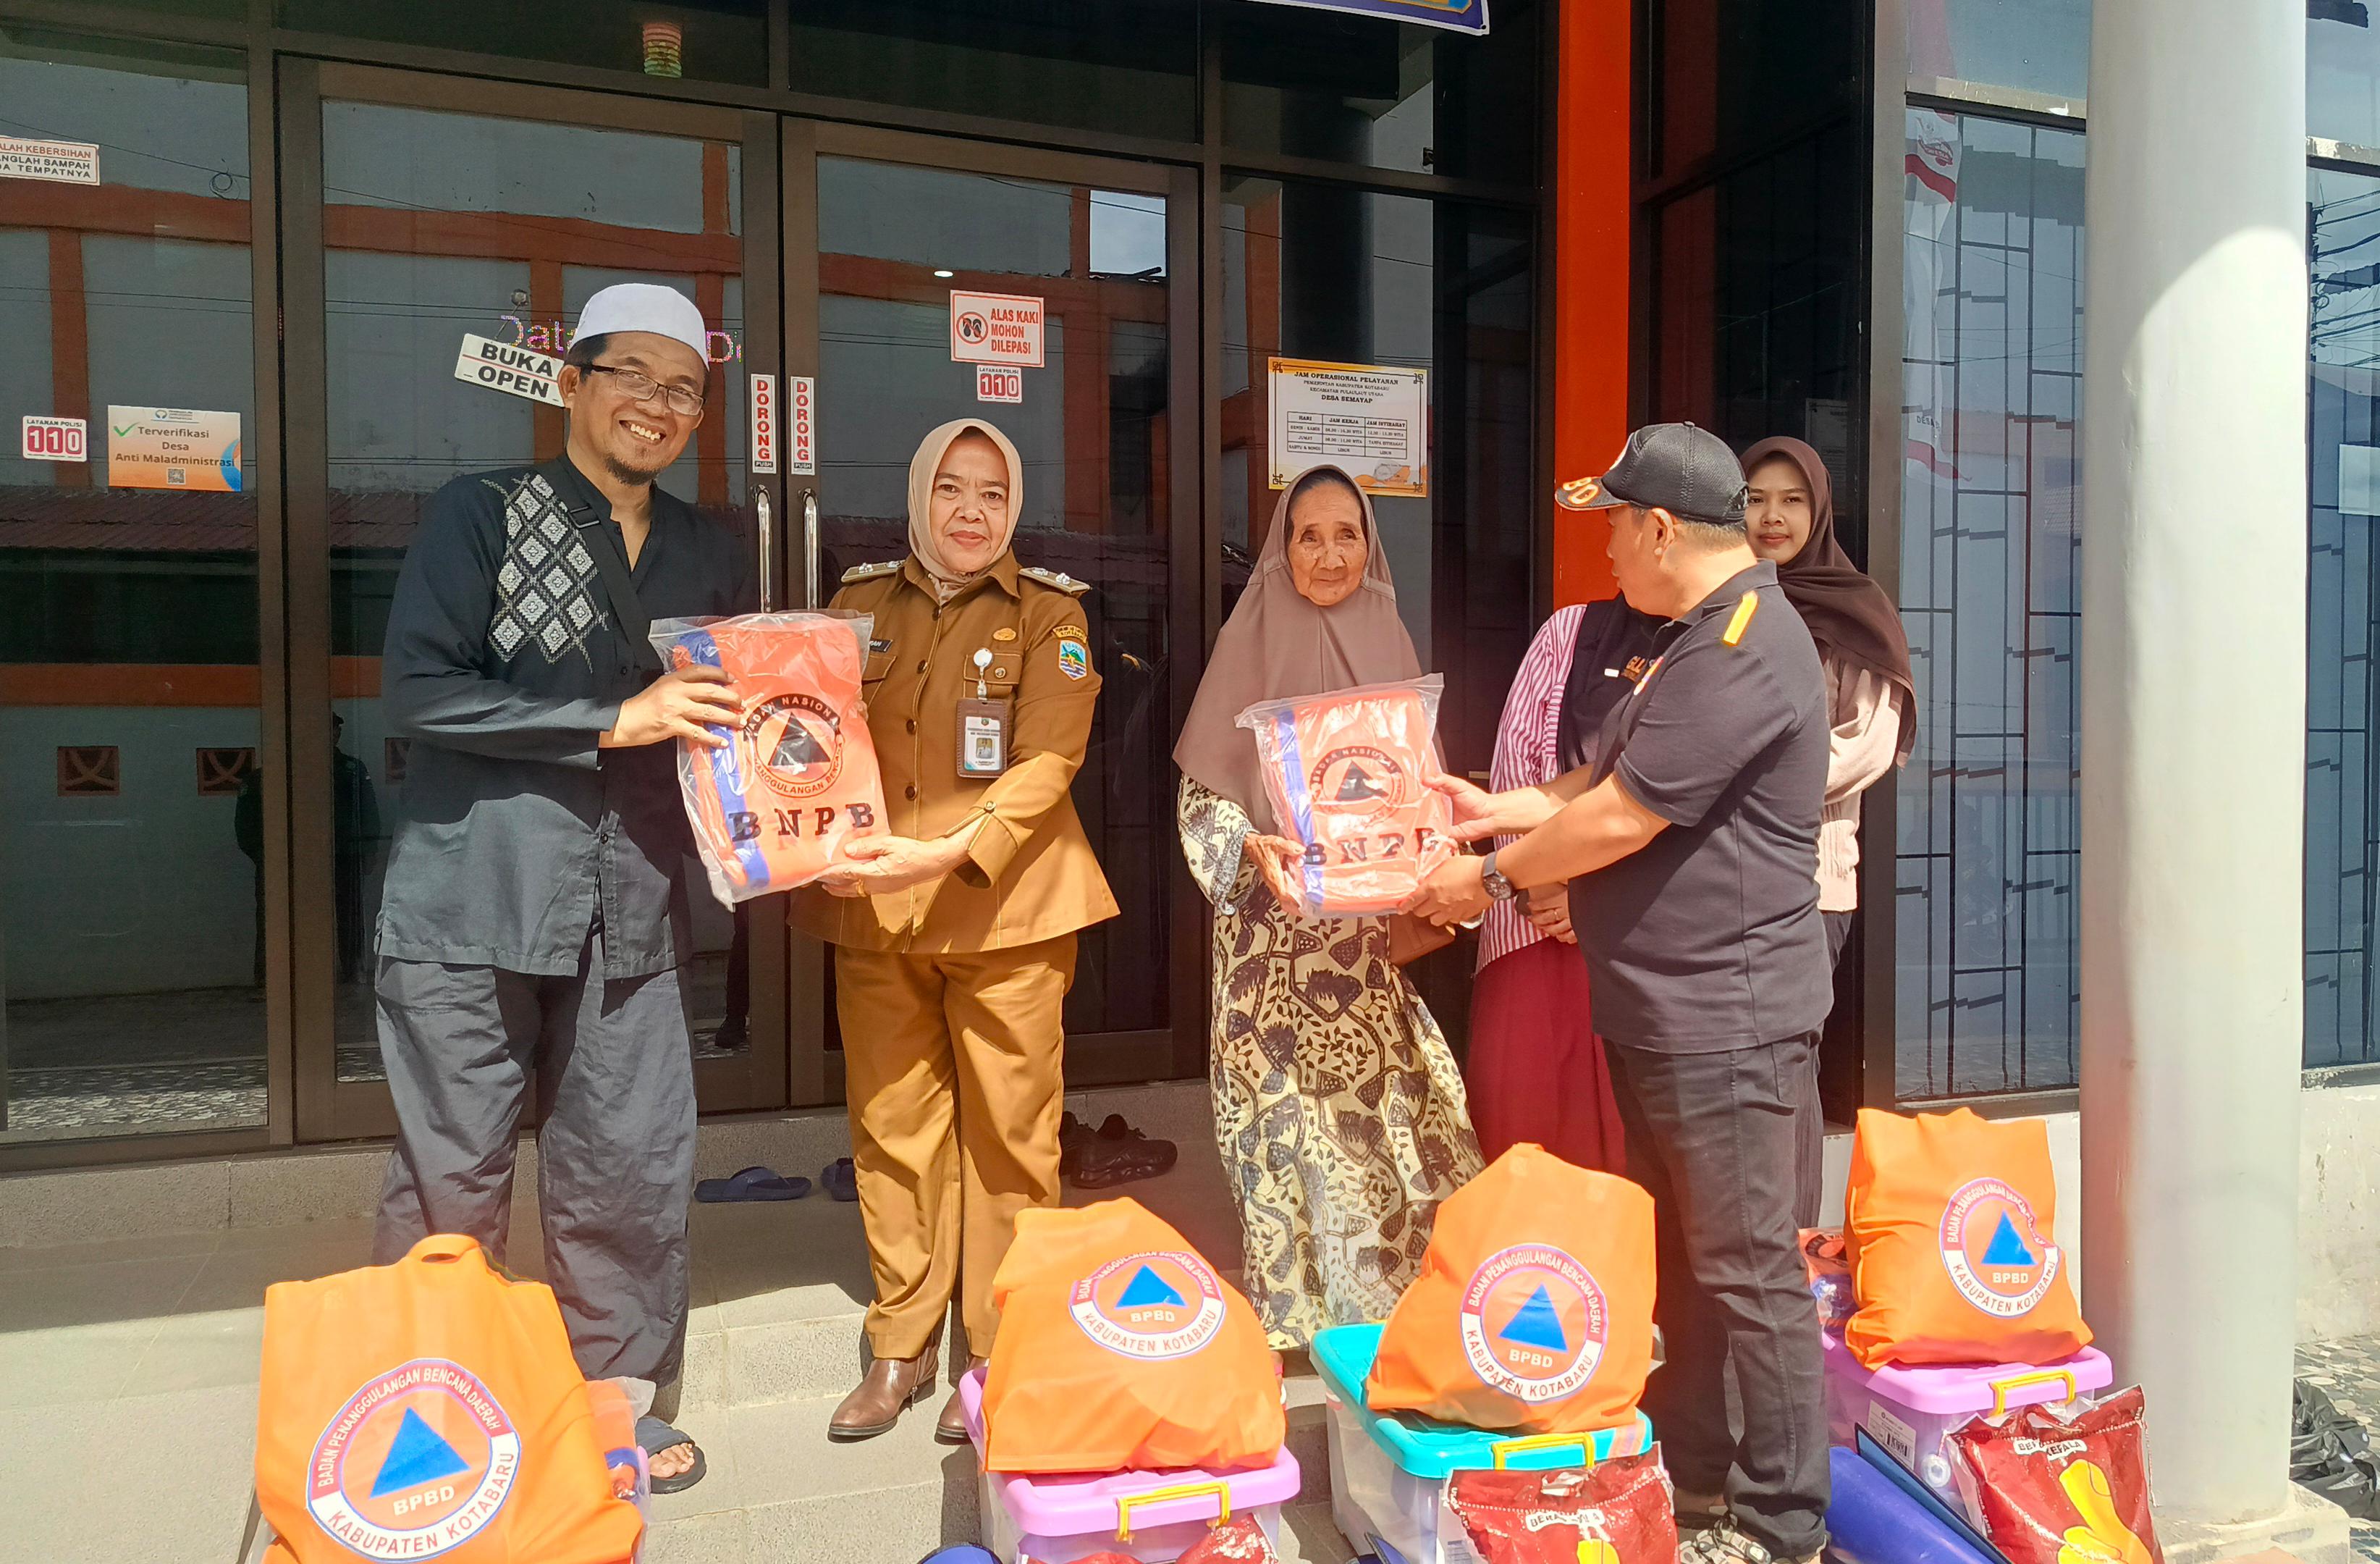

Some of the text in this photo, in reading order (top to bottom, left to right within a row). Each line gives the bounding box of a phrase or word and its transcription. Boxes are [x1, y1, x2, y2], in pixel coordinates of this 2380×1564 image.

[0, 154, 90, 169] NGLAH SAMPAH
[26, 146, 91, 159] KEBERSIHAN
[17, 164, 91, 179] TEMPATNYA
[990, 308, 1039, 324] ALAS KAKI
[991, 324, 1024, 338] MOHON
[991, 339, 1031, 354] DILEPASI
[480, 342, 554, 377] BUKA
[478, 366, 549, 399] OPEN
[981, 376, 1018, 395] 110
[1311, 373, 1358, 382] OPERASIONAL
[1359, 377, 1398, 385] PELAYANAN
[756, 379, 770, 461] DORONG
[796, 381, 809, 461] DORONG
[29, 429, 80, 453] 110
[138, 426, 209, 439] Terverifikasi
[161, 441, 190, 451] Desa
[115, 453, 235, 468] Anti Maladministrasi
[781, 696, 838, 726] NASIONA
[728, 802, 875, 841] BNPB
[1946, 1215, 1962, 1243] BADAN
[1953, 1261, 2055, 1313] KABUPATEN KOTABARU
[1992, 1272, 2029, 1284] BPBD
[1468, 1250, 1602, 1334] BADAN PENANGGULANGAN BENCANA DAERAH
[1130, 1309, 1176, 1323] BPBD
[1081, 1309, 1217, 1352] KABUPATEN KOTABARU
[1467, 1329, 1593, 1397] KABUPATEN KOTABARU
[1508, 1348, 1553, 1368] BPBD
[317, 1367, 502, 1488] BADAN PENANGGULANGAN BENCANA DAERAH
[327, 1452, 515, 1555] KABUPATEN KOTABARU
[392, 1485, 456, 1516] BPBD
